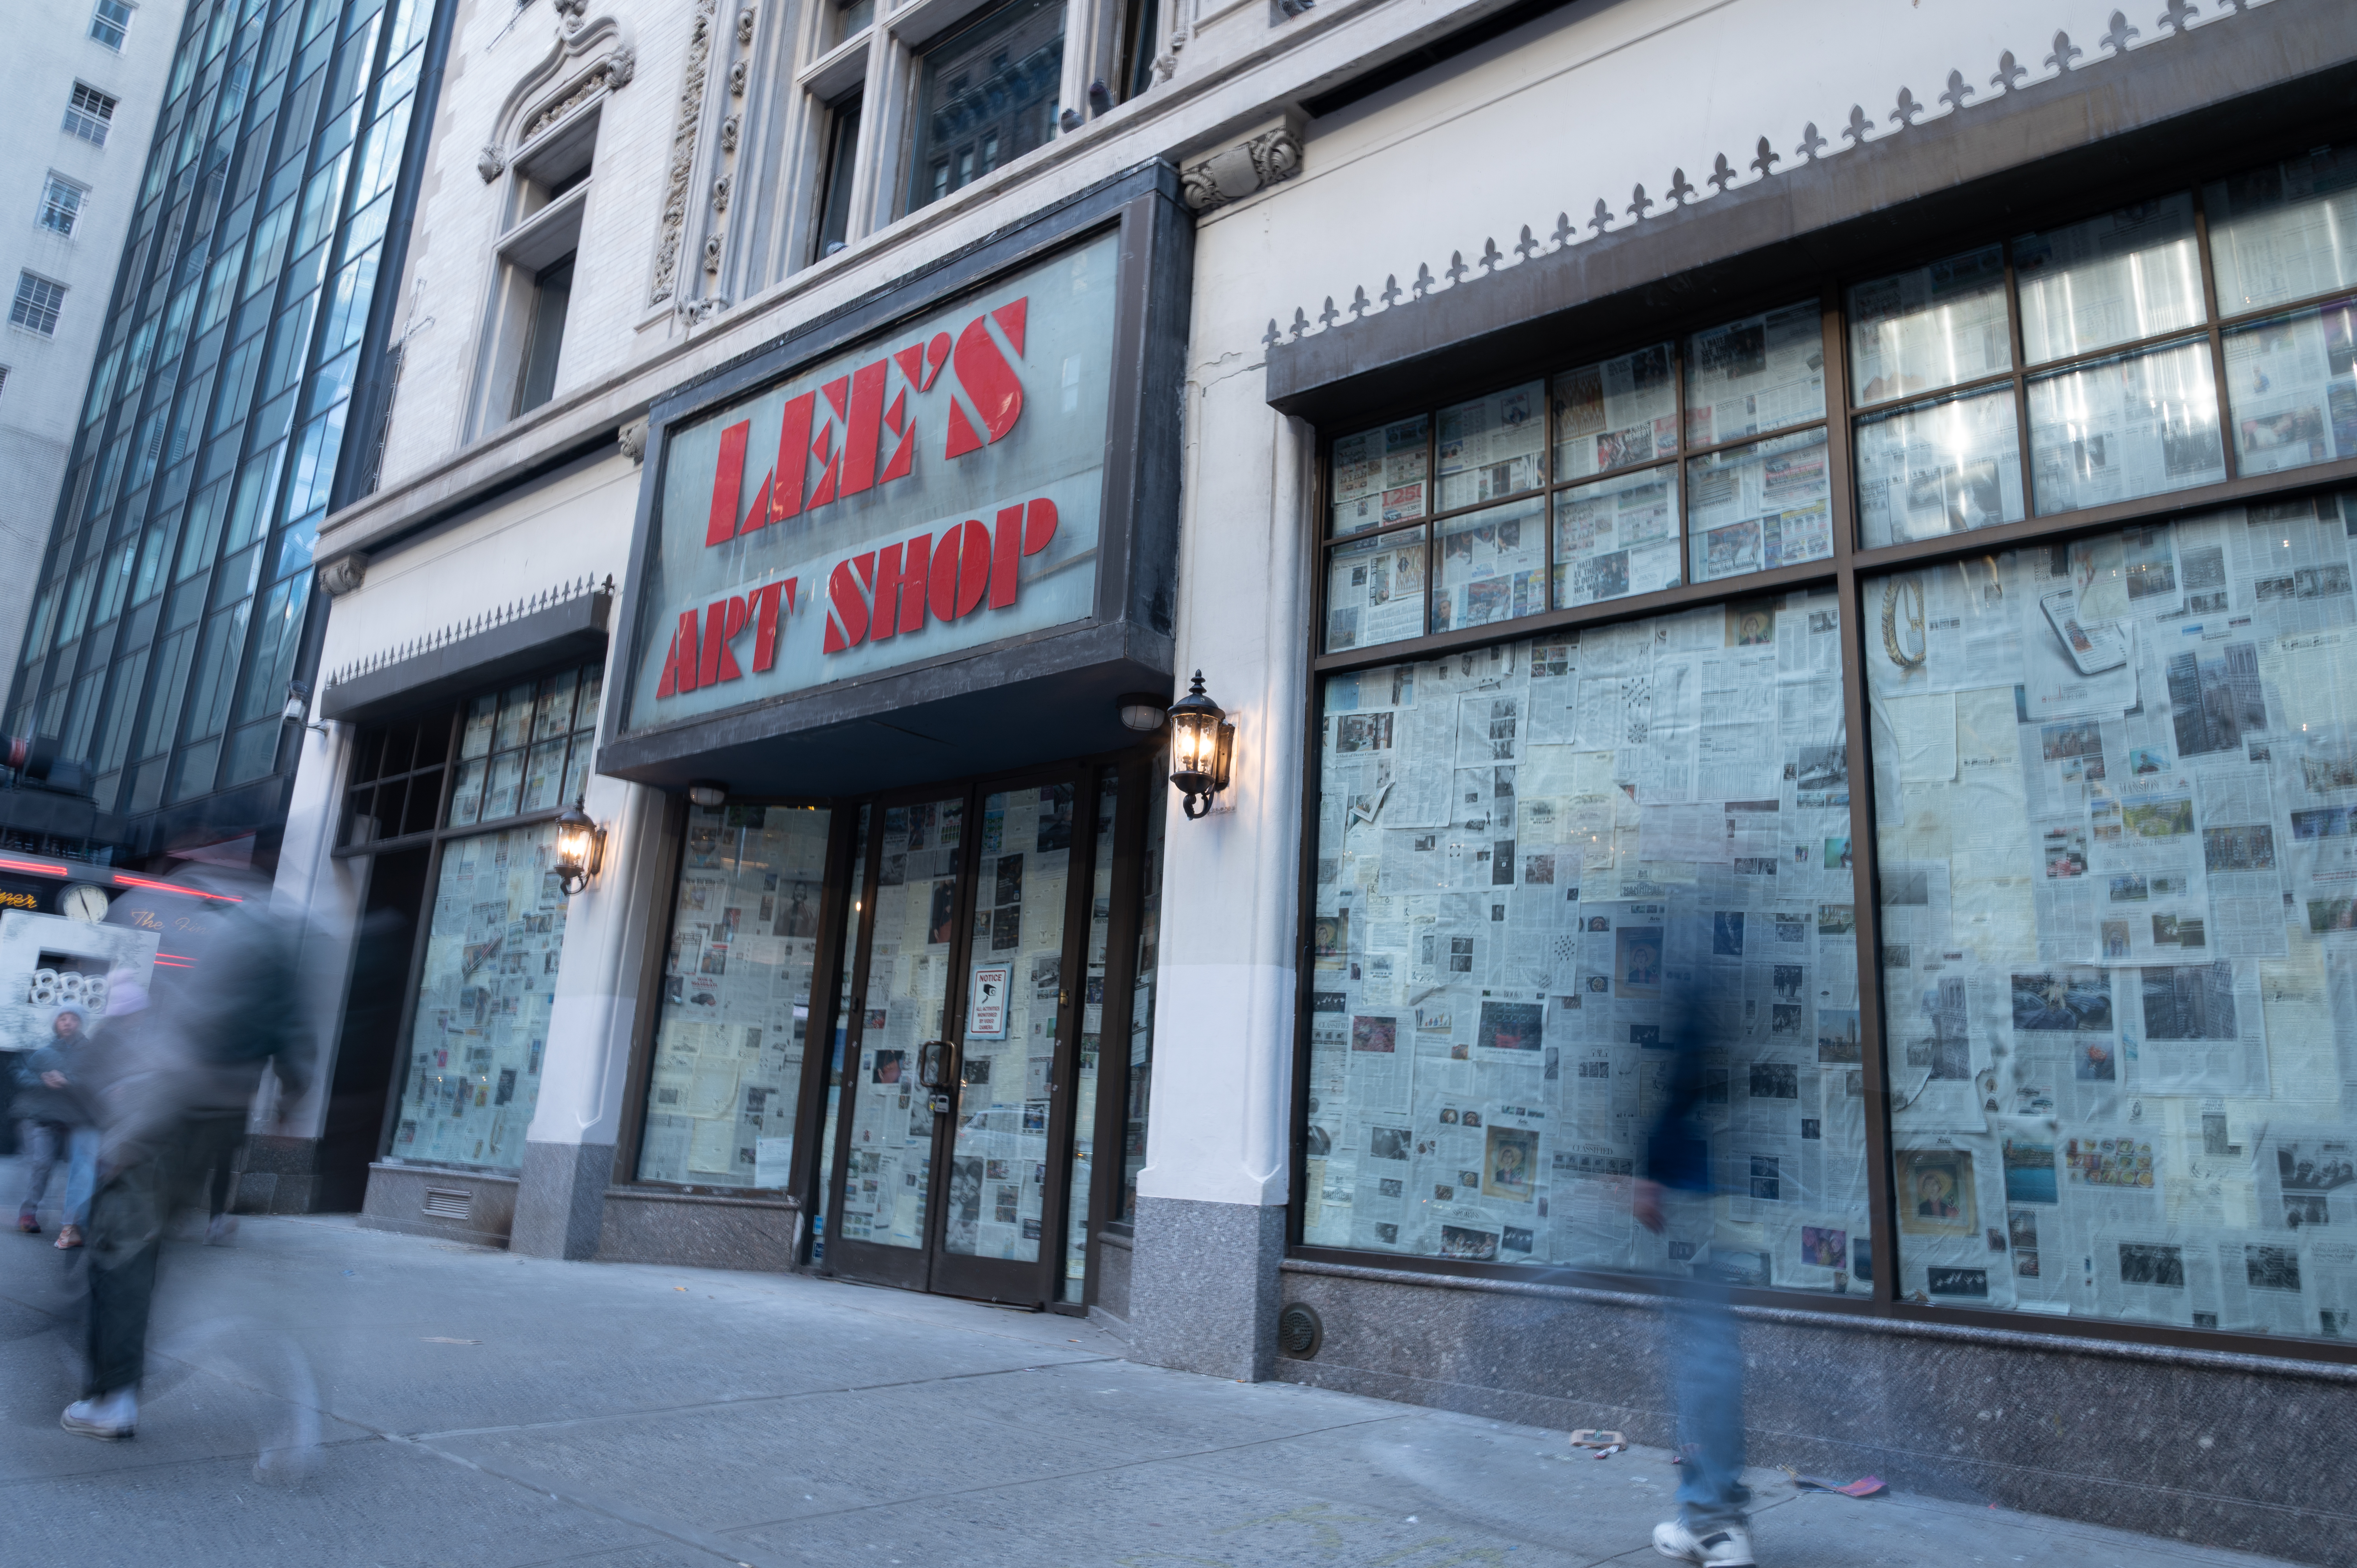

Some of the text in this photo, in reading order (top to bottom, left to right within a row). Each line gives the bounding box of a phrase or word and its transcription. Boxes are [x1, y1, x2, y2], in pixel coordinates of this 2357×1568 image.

[705, 295, 1028, 547] LEE'S
[656, 497, 1058, 701] ART SHOP
[2119, 779, 2159, 795] MANSION
[2108, 841, 2130, 849] Selling
[2155, 837, 2182, 846] Disaster
[132, 908, 165, 930] The
[1503, 990, 1522, 999] BOOKS
[1573, 1144, 1613, 1155] CLASSIFIED
